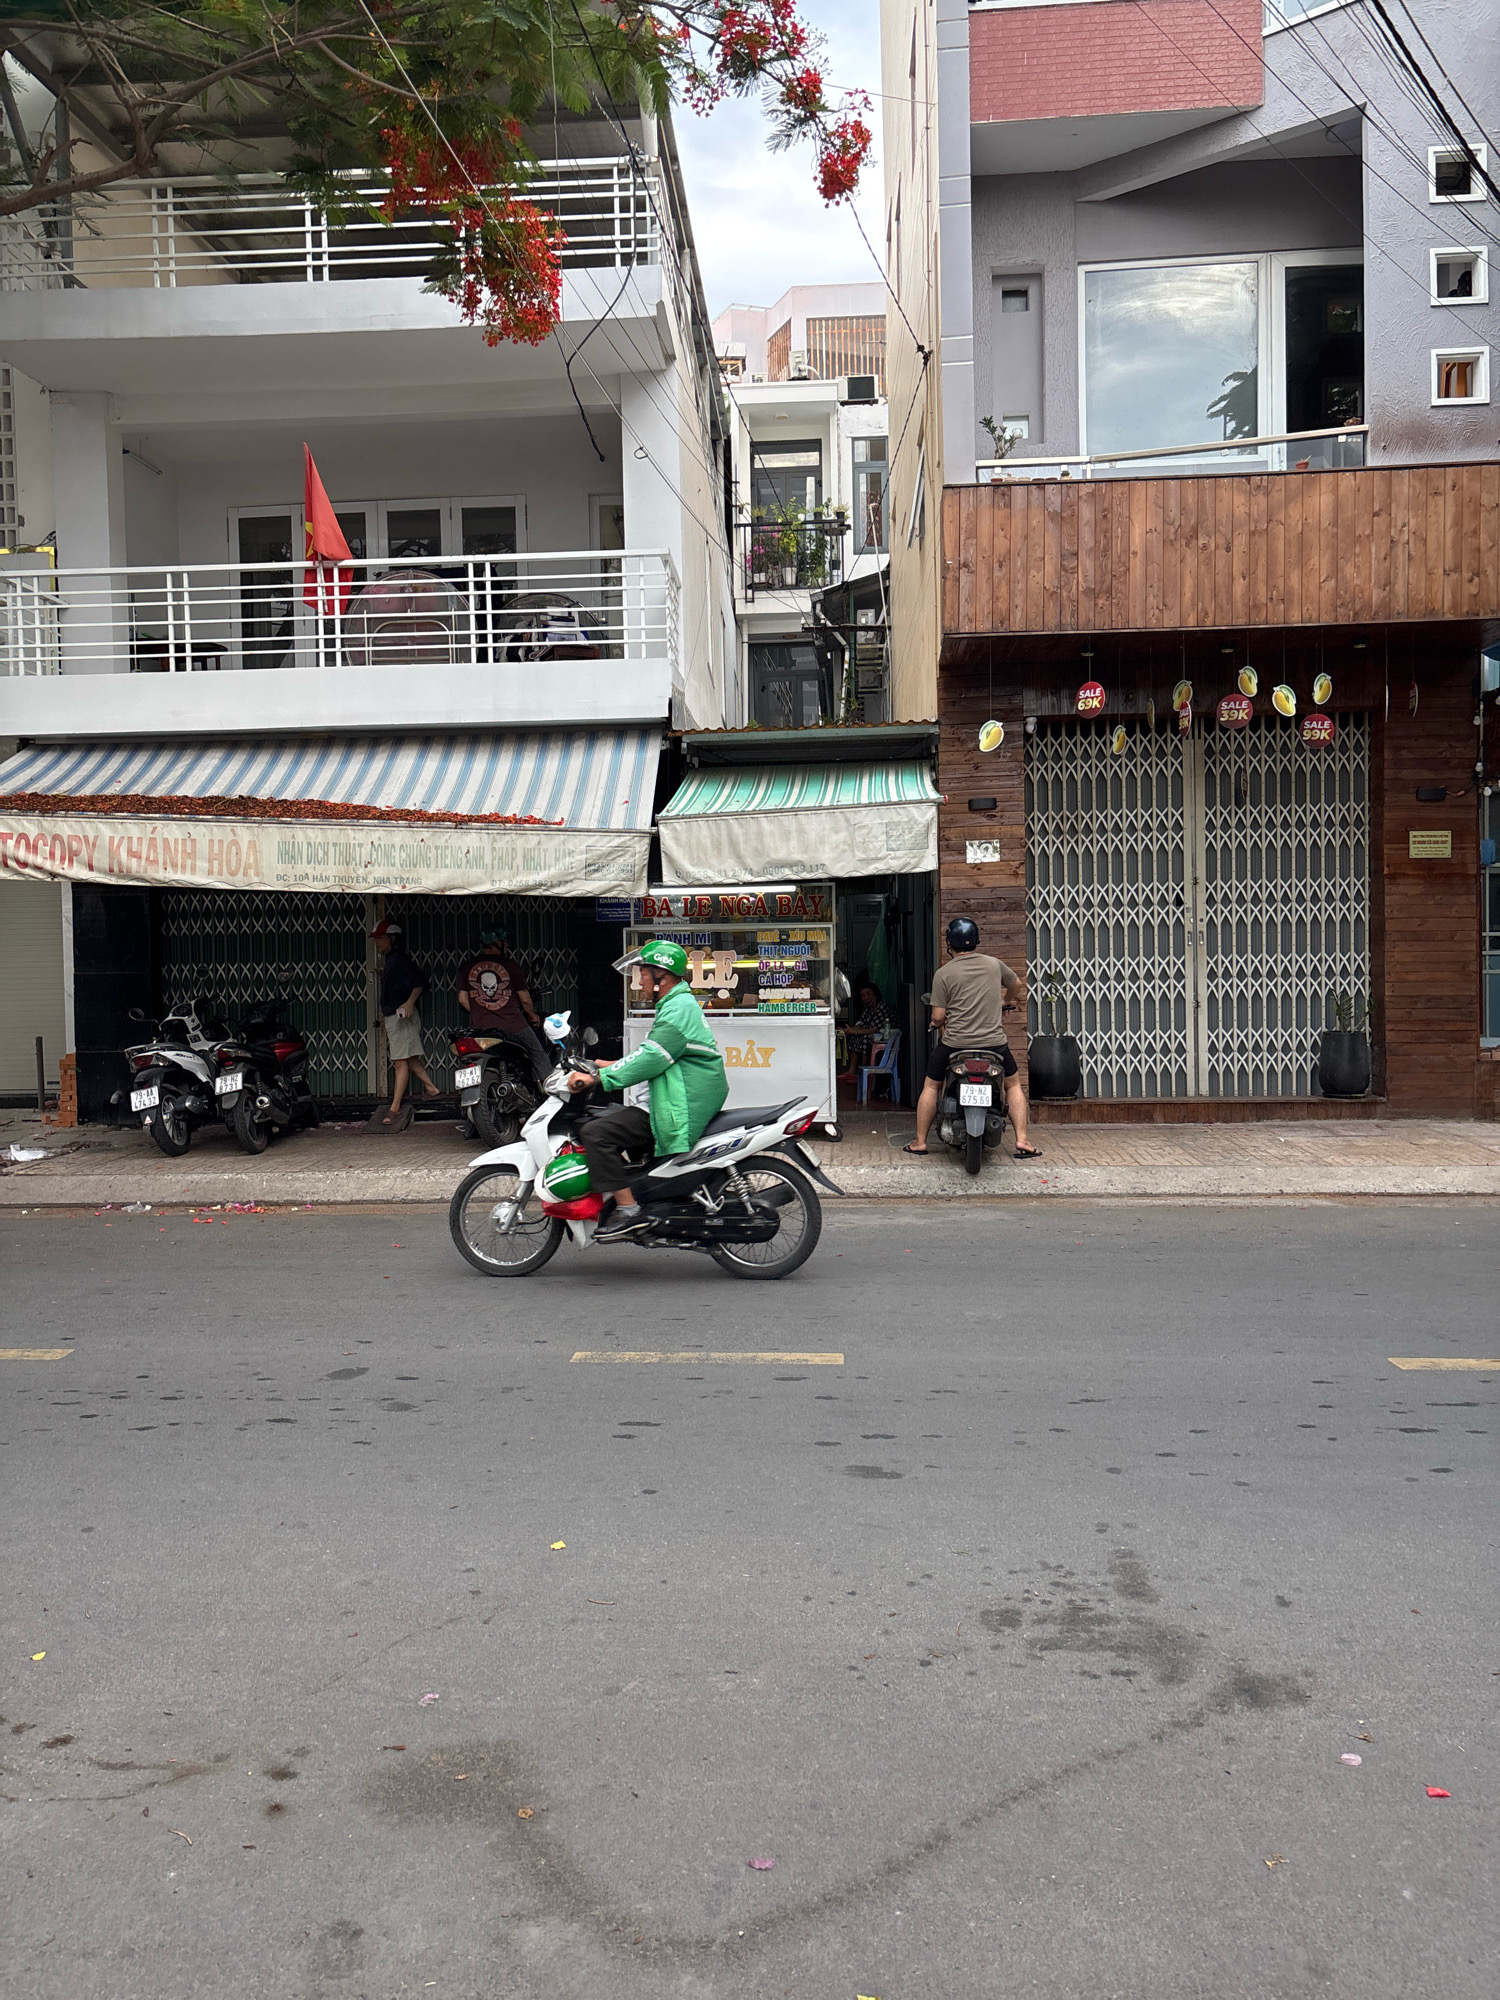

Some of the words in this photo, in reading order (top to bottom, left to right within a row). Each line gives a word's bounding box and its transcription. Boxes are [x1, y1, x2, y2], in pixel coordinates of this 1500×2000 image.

[1079, 688, 1101, 698] SALE
[1077, 696, 1102, 711] 69K
[1221, 701, 1249, 710] SALE
[1219, 709, 1250, 721] 39K
[1303, 720, 1331, 729] SALE
[1302, 729, 1332, 741] 99K
[108, 827, 197, 874] KHÁNH
[207, 829, 260, 878] HÒA
[277, 834, 303, 870] NHẬN
[306, 841, 329, 871] DỊCH
[370, 836, 396, 868] CÔNG
[434, 835, 462, 869] TIẾNG
[276, 873, 290, 882] ĐC:
[373, 877, 391, 885] NHA
[394, 877, 422, 885] TRANG
[642, 896, 673, 918] BA
[682, 895, 712, 923] LẸ
[776, 888, 825, 917] BẢY
[758, 944, 779, 958] THỊT
[781, 943, 811, 959] NGUỘI
[653, 953, 675, 966] Grab
[774, 972, 794, 987] HỘP
[758, 1002, 817, 1014] HAMBERGER
[725, 1039, 776, 1068] BẢY
